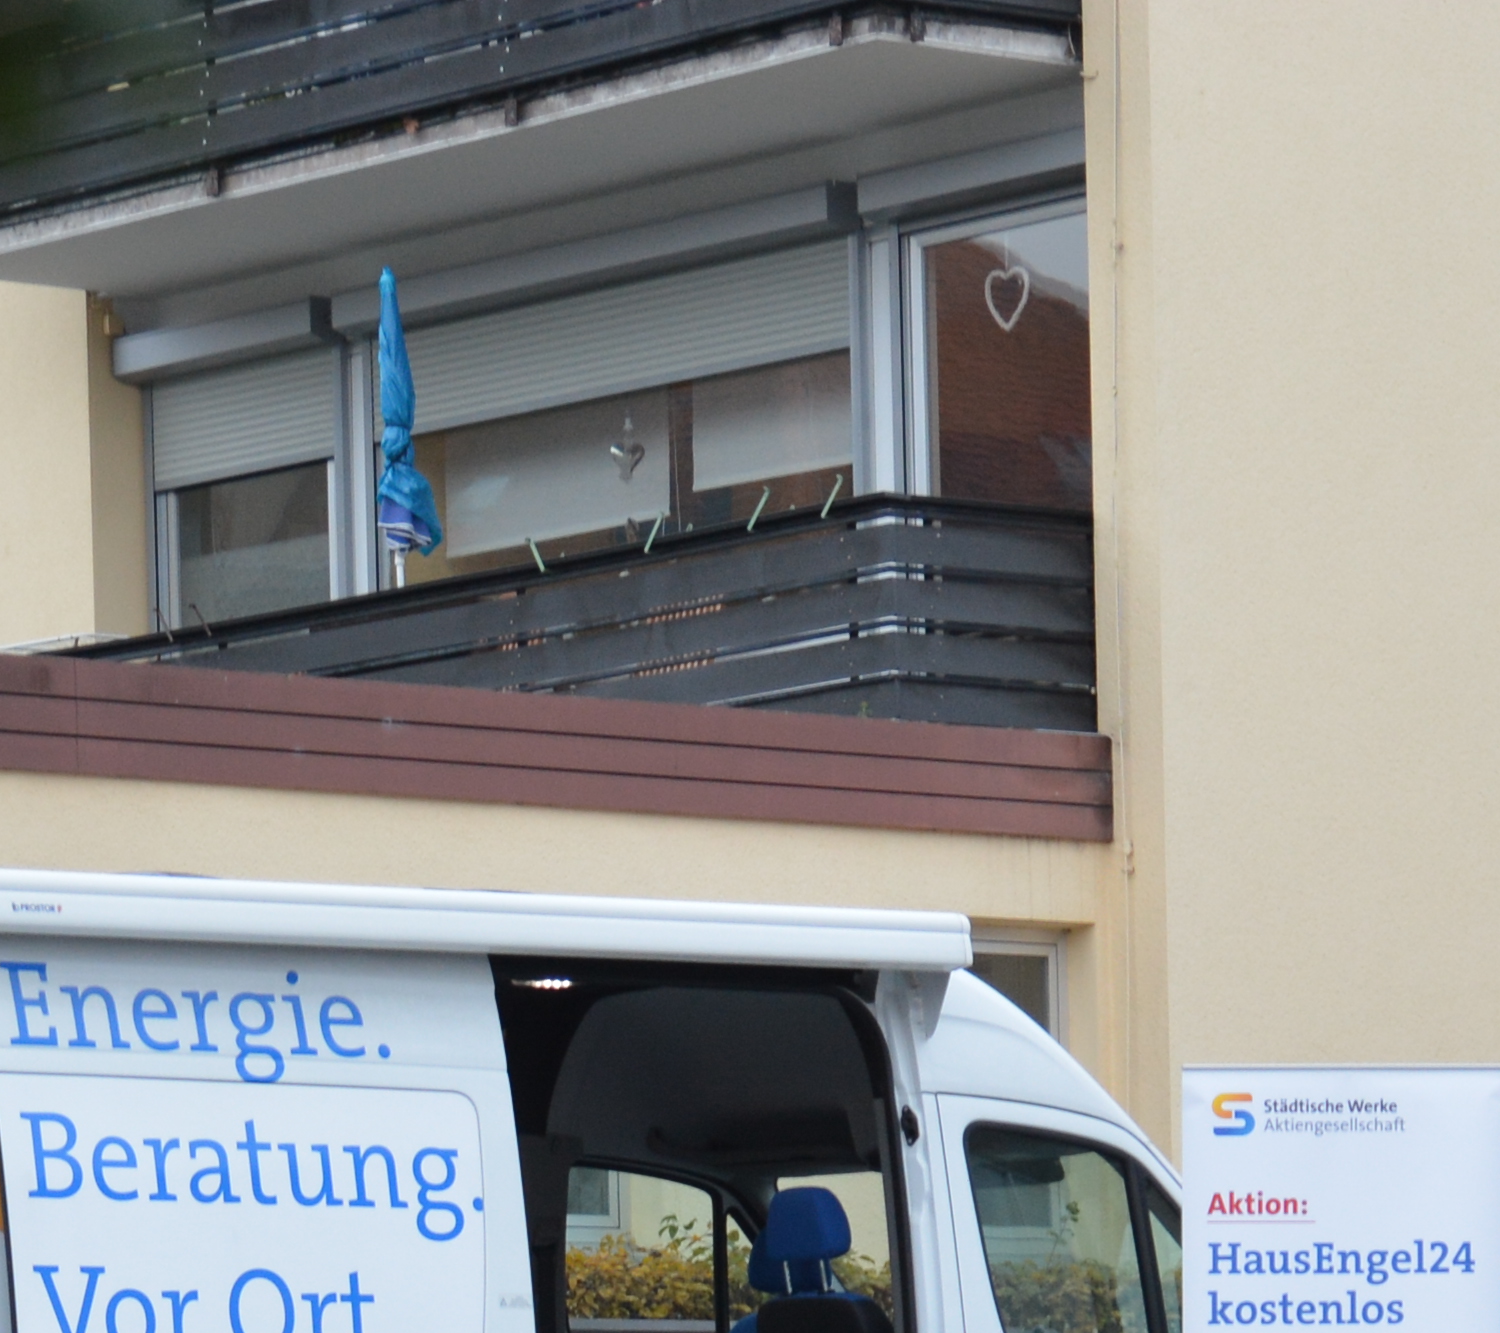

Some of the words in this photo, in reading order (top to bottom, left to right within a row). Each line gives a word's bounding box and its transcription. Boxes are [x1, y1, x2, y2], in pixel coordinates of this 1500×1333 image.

[1264, 1098, 1344, 1114] Städtische
[1347, 1098, 1398, 1114] Werke
[1263, 1116, 1405, 1137] Aktiengesellschaft
[20, 1110, 484, 1242] Beratung.
[1207, 1190, 1309, 1215] Aktion:
[1207, 1238, 1476, 1285] HausEngel24
[1207, 1290, 1405, 1325] kostenlos
